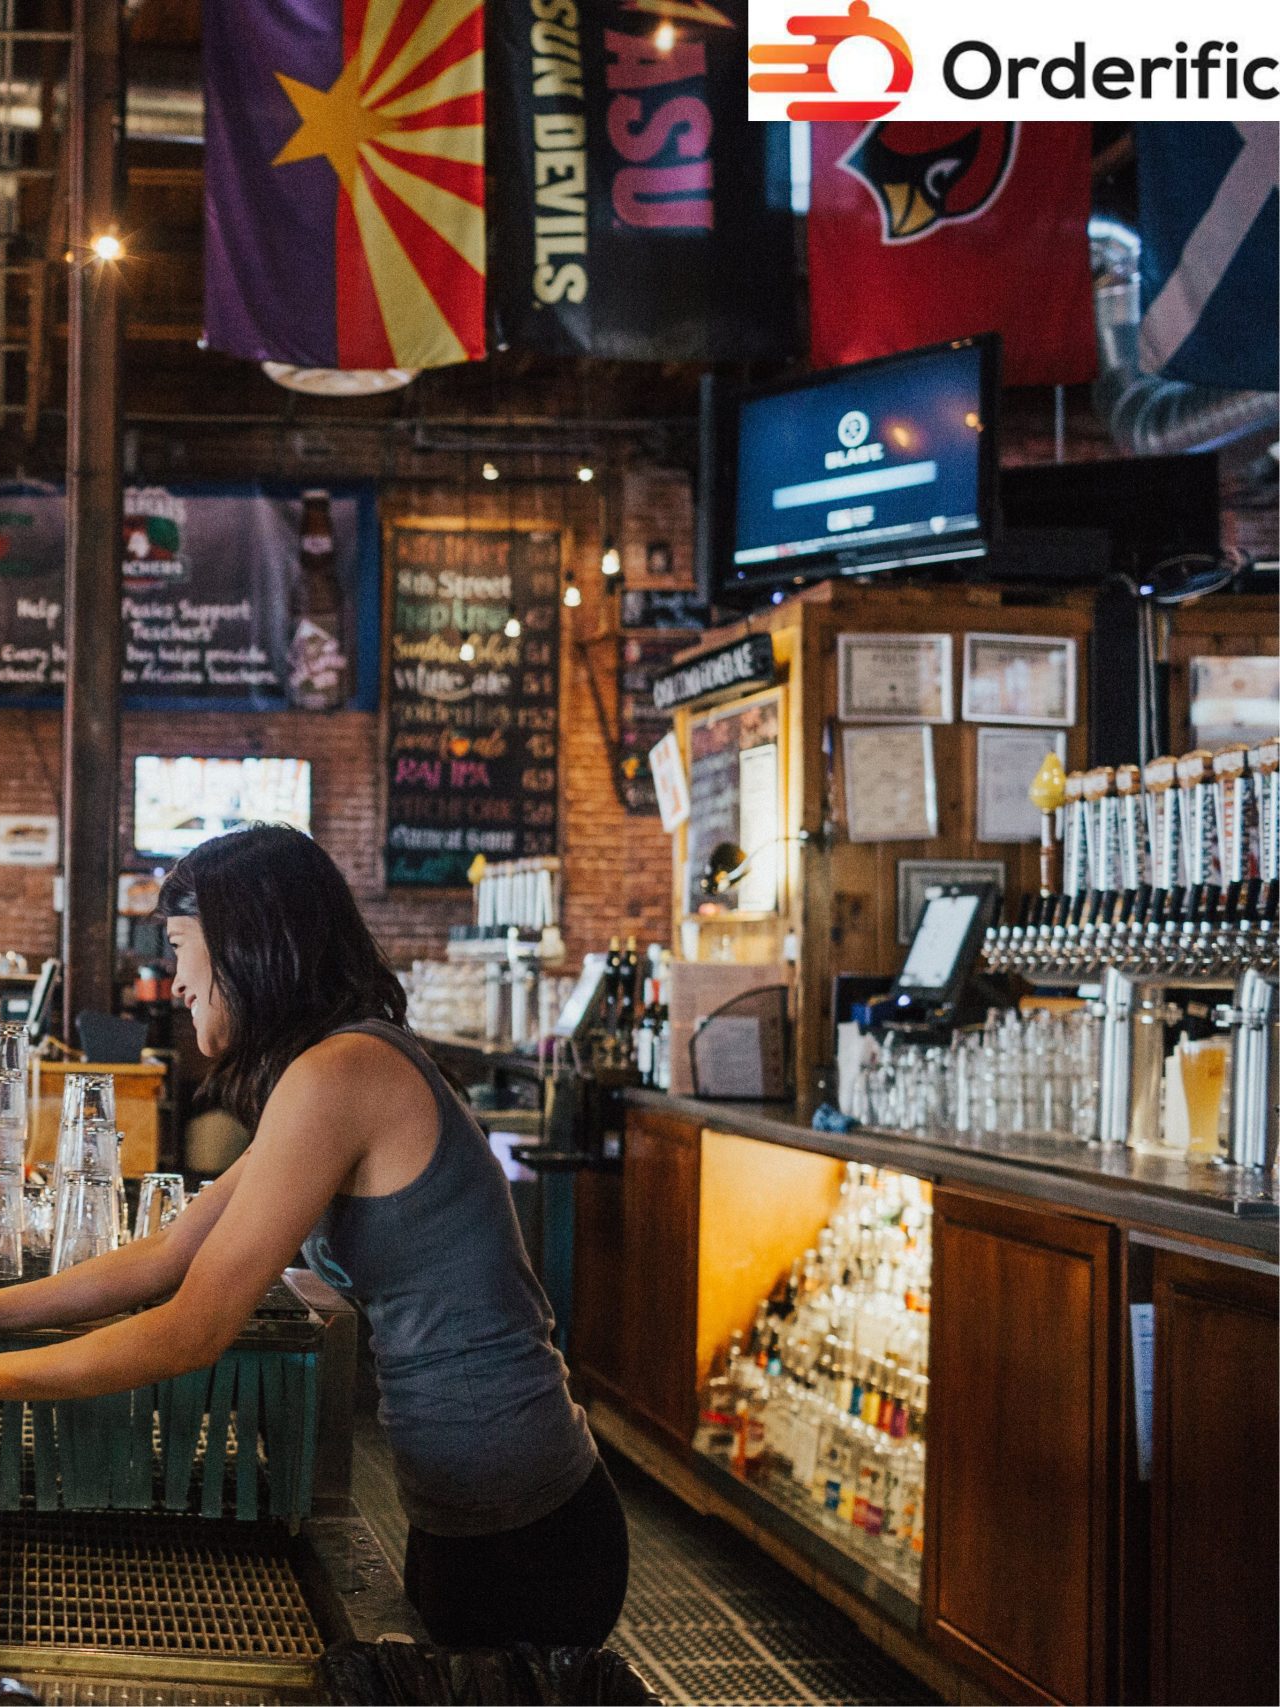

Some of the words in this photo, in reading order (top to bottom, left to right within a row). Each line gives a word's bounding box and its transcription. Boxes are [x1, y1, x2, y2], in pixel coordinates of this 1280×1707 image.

[530, 0, 584, 98] SUN
[604, 28, 715, 230] ASU
[533, 113, 588, 304] DEVILS
[17, 597, 61, 631] Help
[179, 597, 250, 631] Support
[438, 569, 512, 600] Street
[451, 760, 489, 788] IPA
